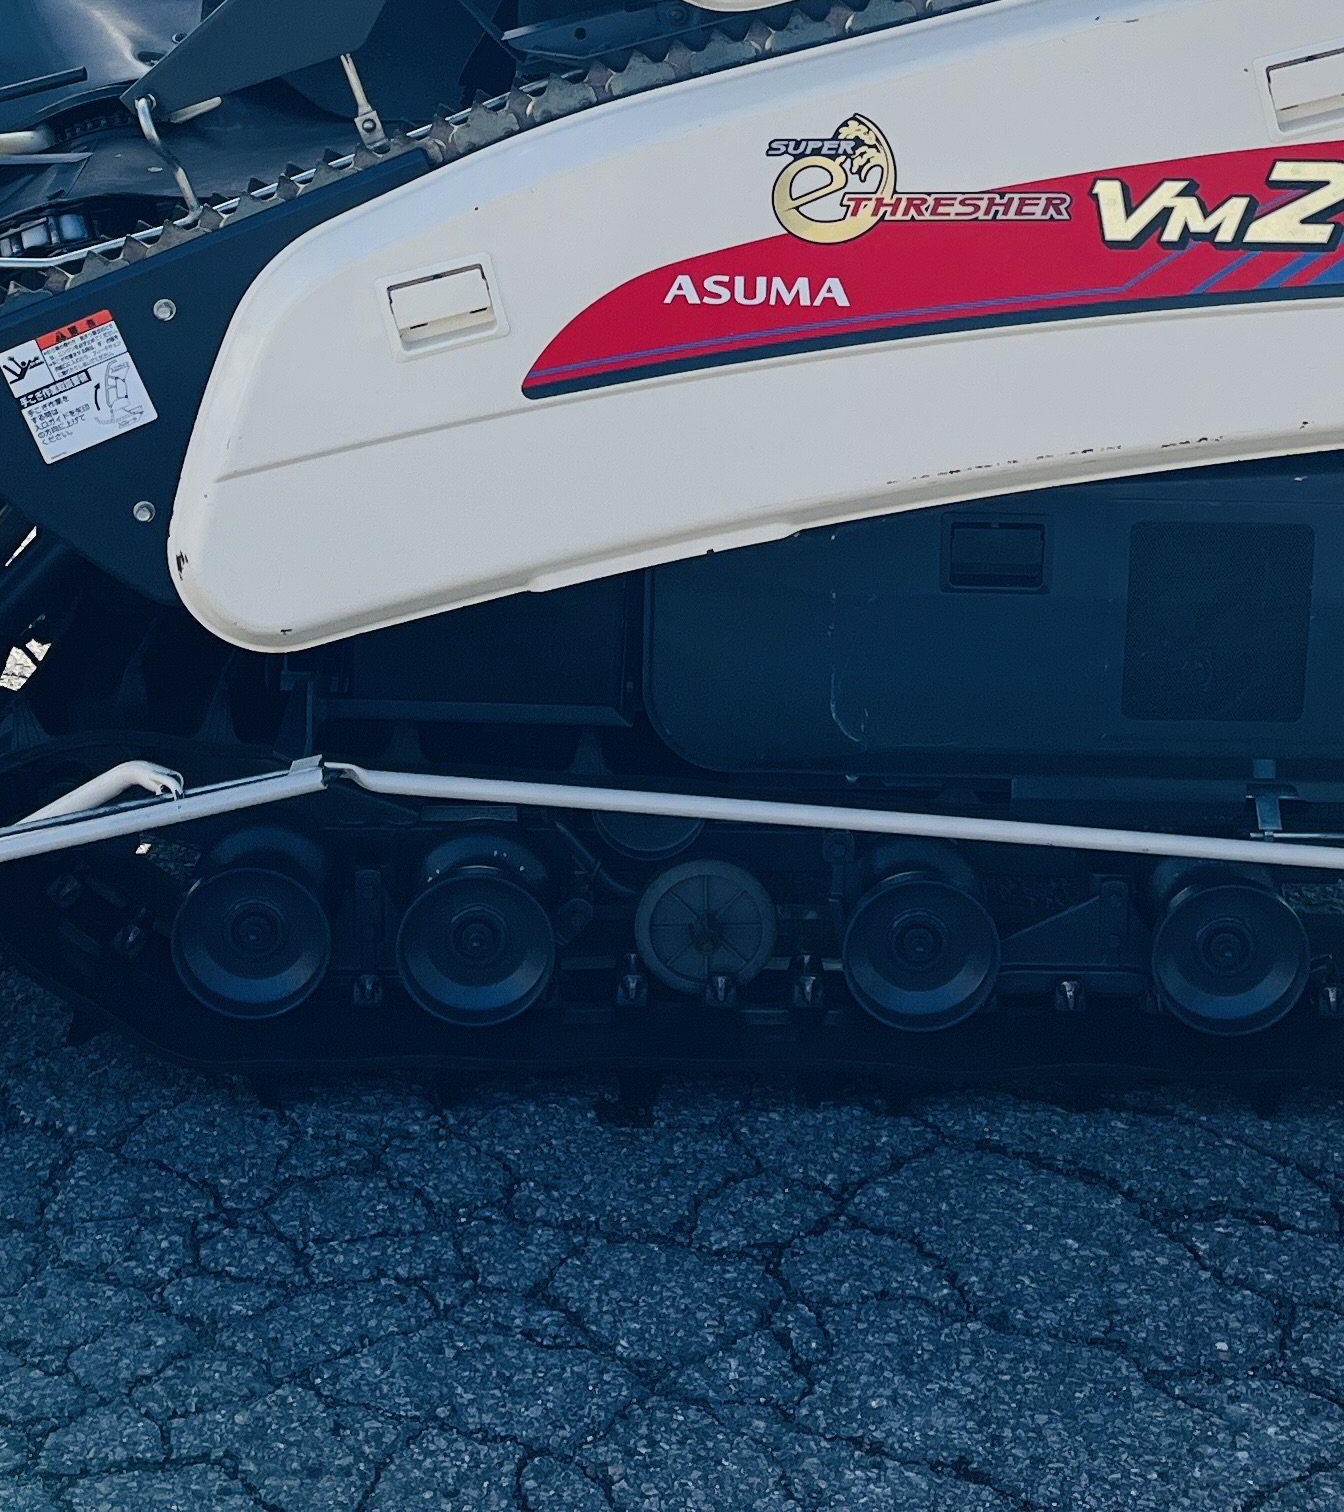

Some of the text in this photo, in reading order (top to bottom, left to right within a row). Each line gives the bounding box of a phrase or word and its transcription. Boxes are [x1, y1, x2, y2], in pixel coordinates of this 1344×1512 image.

[766, 139, 856, 156] SUPER
[843, 193, 1071, 220] THRESHER
[663, 274, 851, 307] ASUMA
